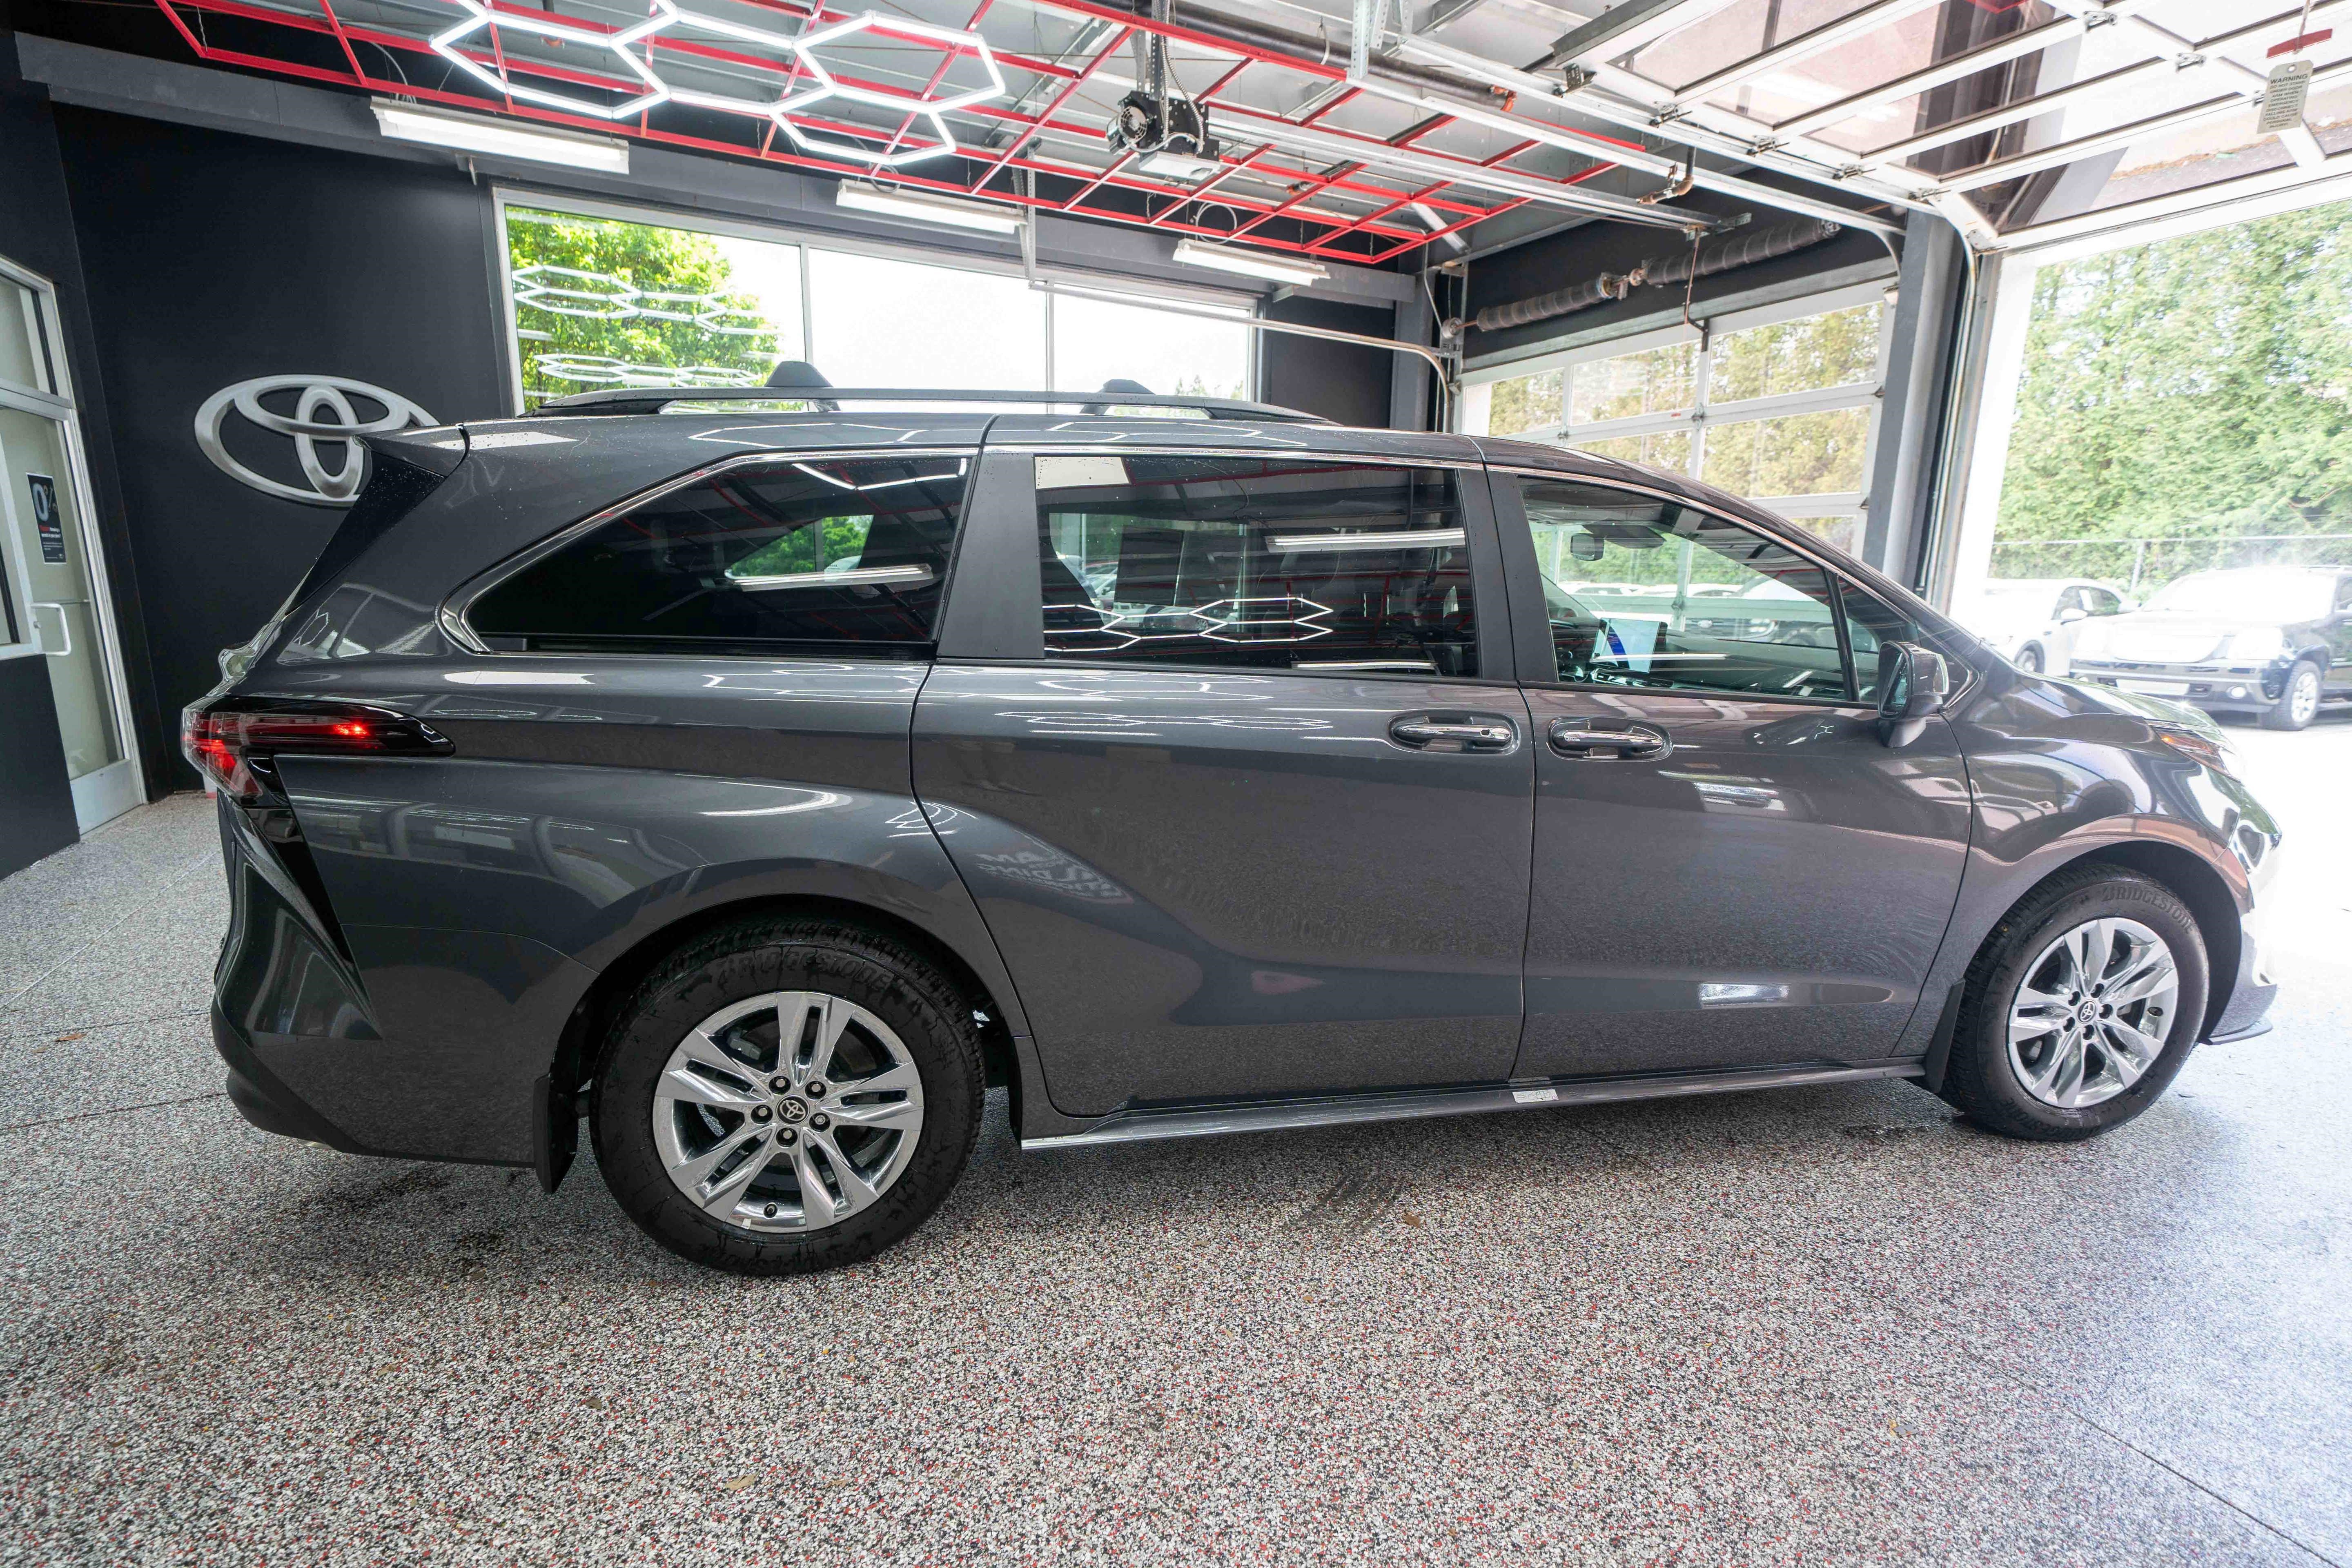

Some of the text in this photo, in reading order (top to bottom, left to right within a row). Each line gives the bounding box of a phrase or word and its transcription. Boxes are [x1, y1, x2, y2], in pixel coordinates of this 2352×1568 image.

[2270, 74, 2308, 84] WARNING
[2266, 104, 2298, 112] DISCONNECT
[2102, 885, 2192, 934] BRIDGESTONE
